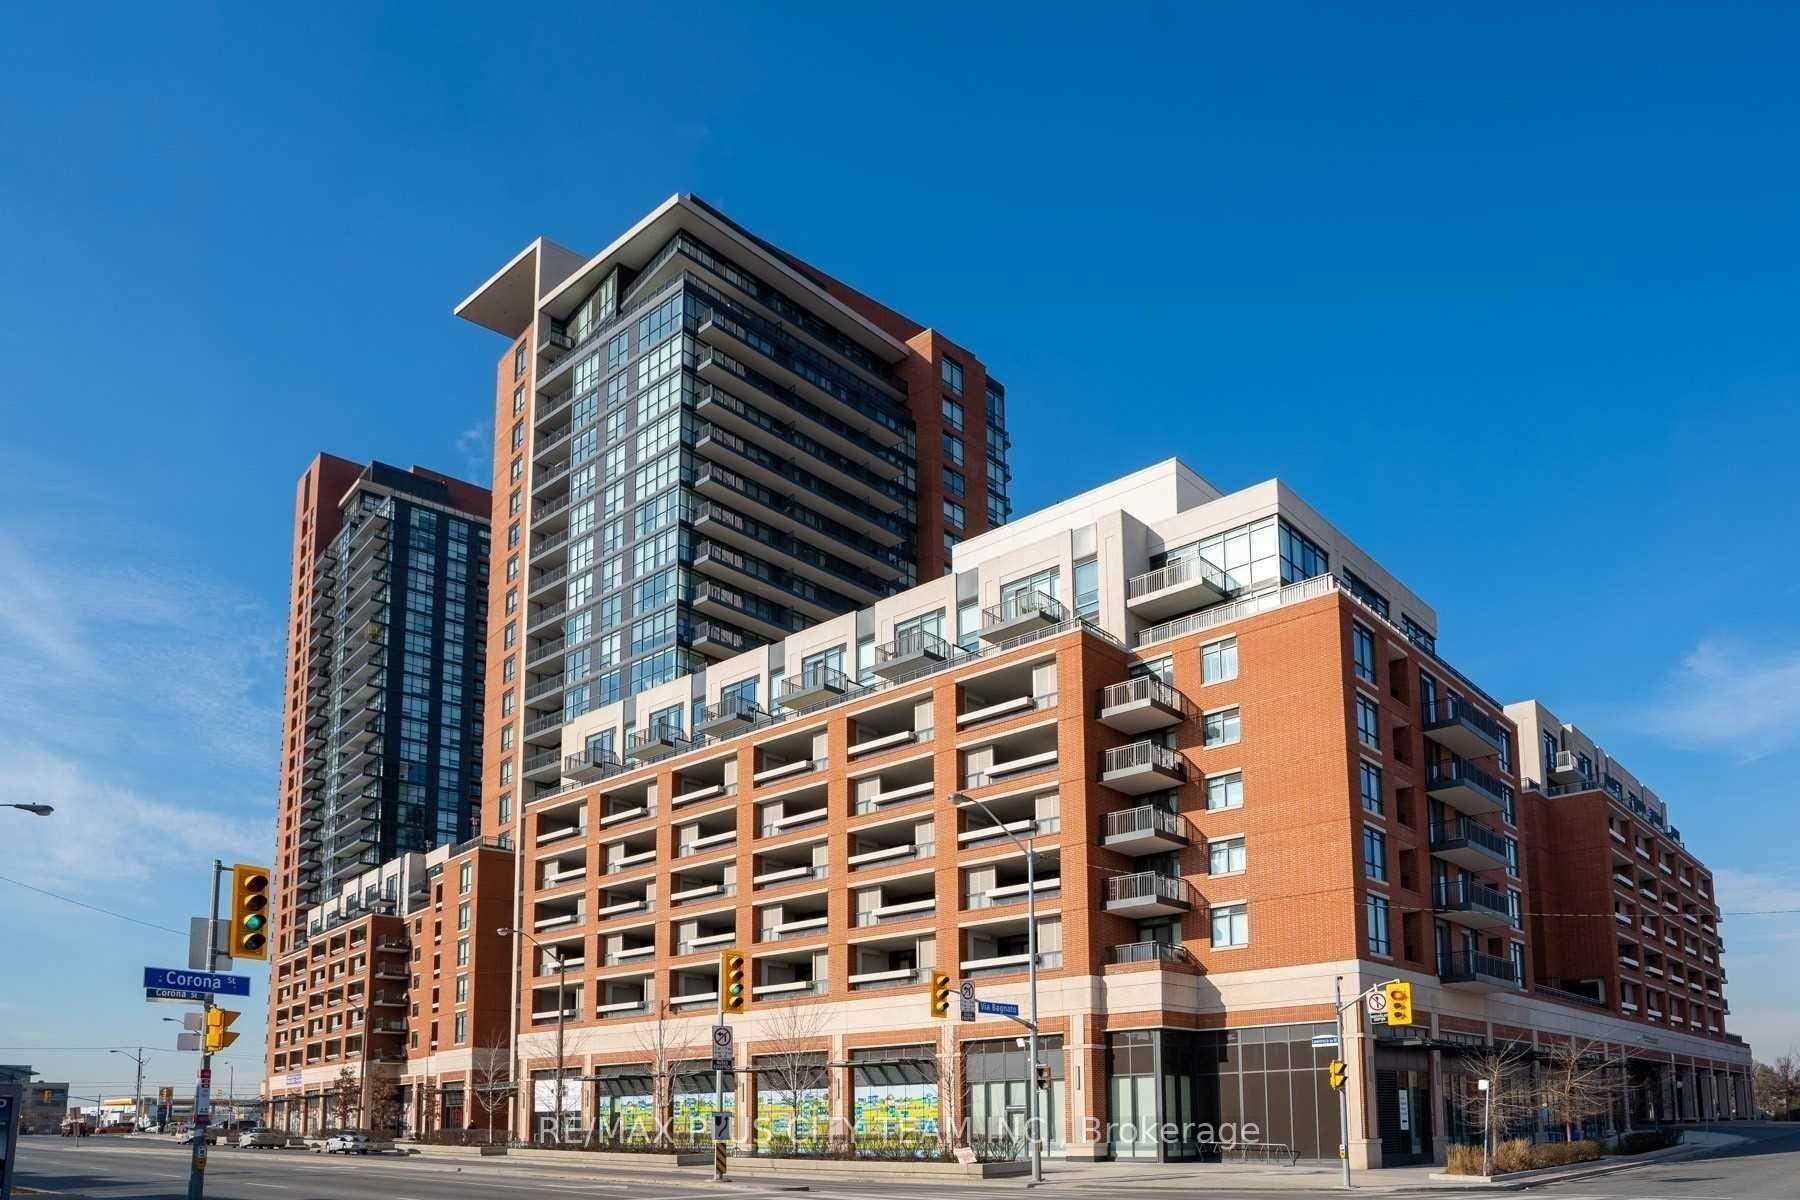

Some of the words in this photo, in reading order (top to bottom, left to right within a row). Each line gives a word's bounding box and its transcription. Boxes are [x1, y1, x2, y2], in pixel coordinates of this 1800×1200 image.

[166, 971, 221, 989] Corona
[227, 976, 237, 985] St
[156, 989, 187, 998] Corona
[981, 1002, 991, 1012] Via
